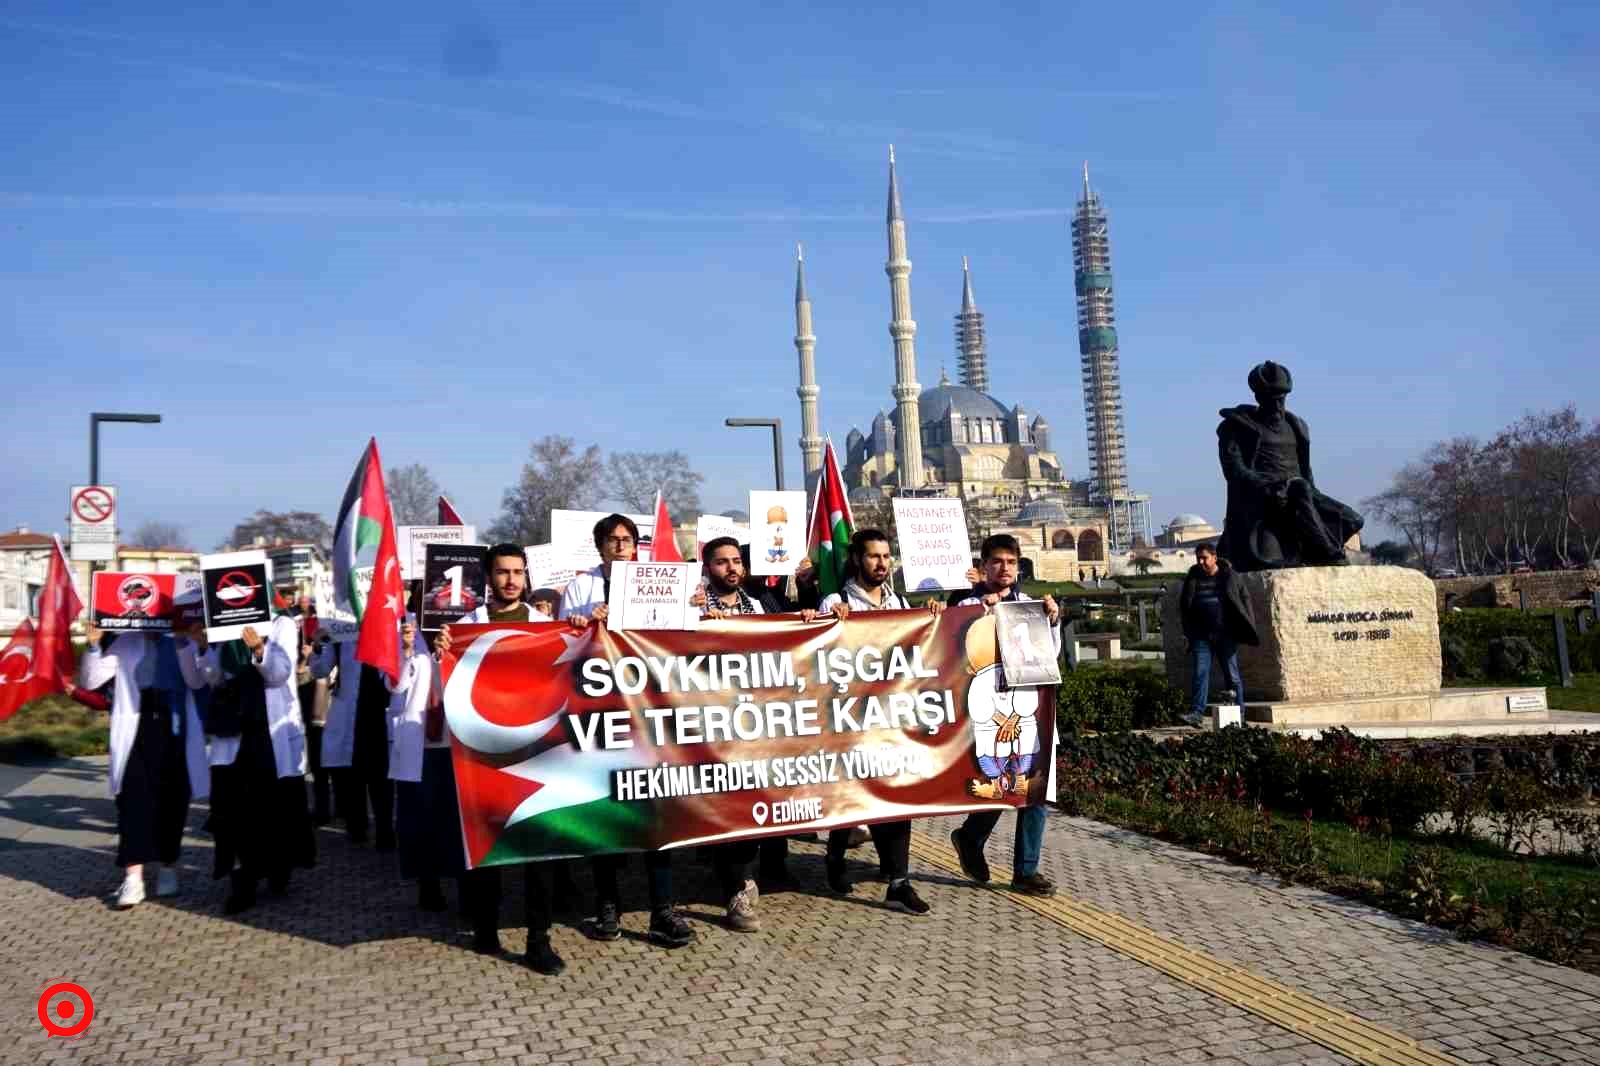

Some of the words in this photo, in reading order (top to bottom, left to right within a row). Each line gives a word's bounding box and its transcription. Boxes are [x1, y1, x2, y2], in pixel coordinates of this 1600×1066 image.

[897, 507, 961, 519] HASTANEYE
[443, 565, 463, 606] 1
[636, 566, 678, 578] BEYAZ
[637, 585, 673, 597] KANA
[582, 651, 807, 697] SOYKIRIM,
[568, 711, 634, 752] VE
[644, 694, 822, 746] TERÖRE
[832, 689, 956, 735] KARŞI
[616, 761, 769, 801] HEKİMLERDEN
[771, 749, 840, 788] SESSİZ
[772, 796, 824, 824] EDİRNE
